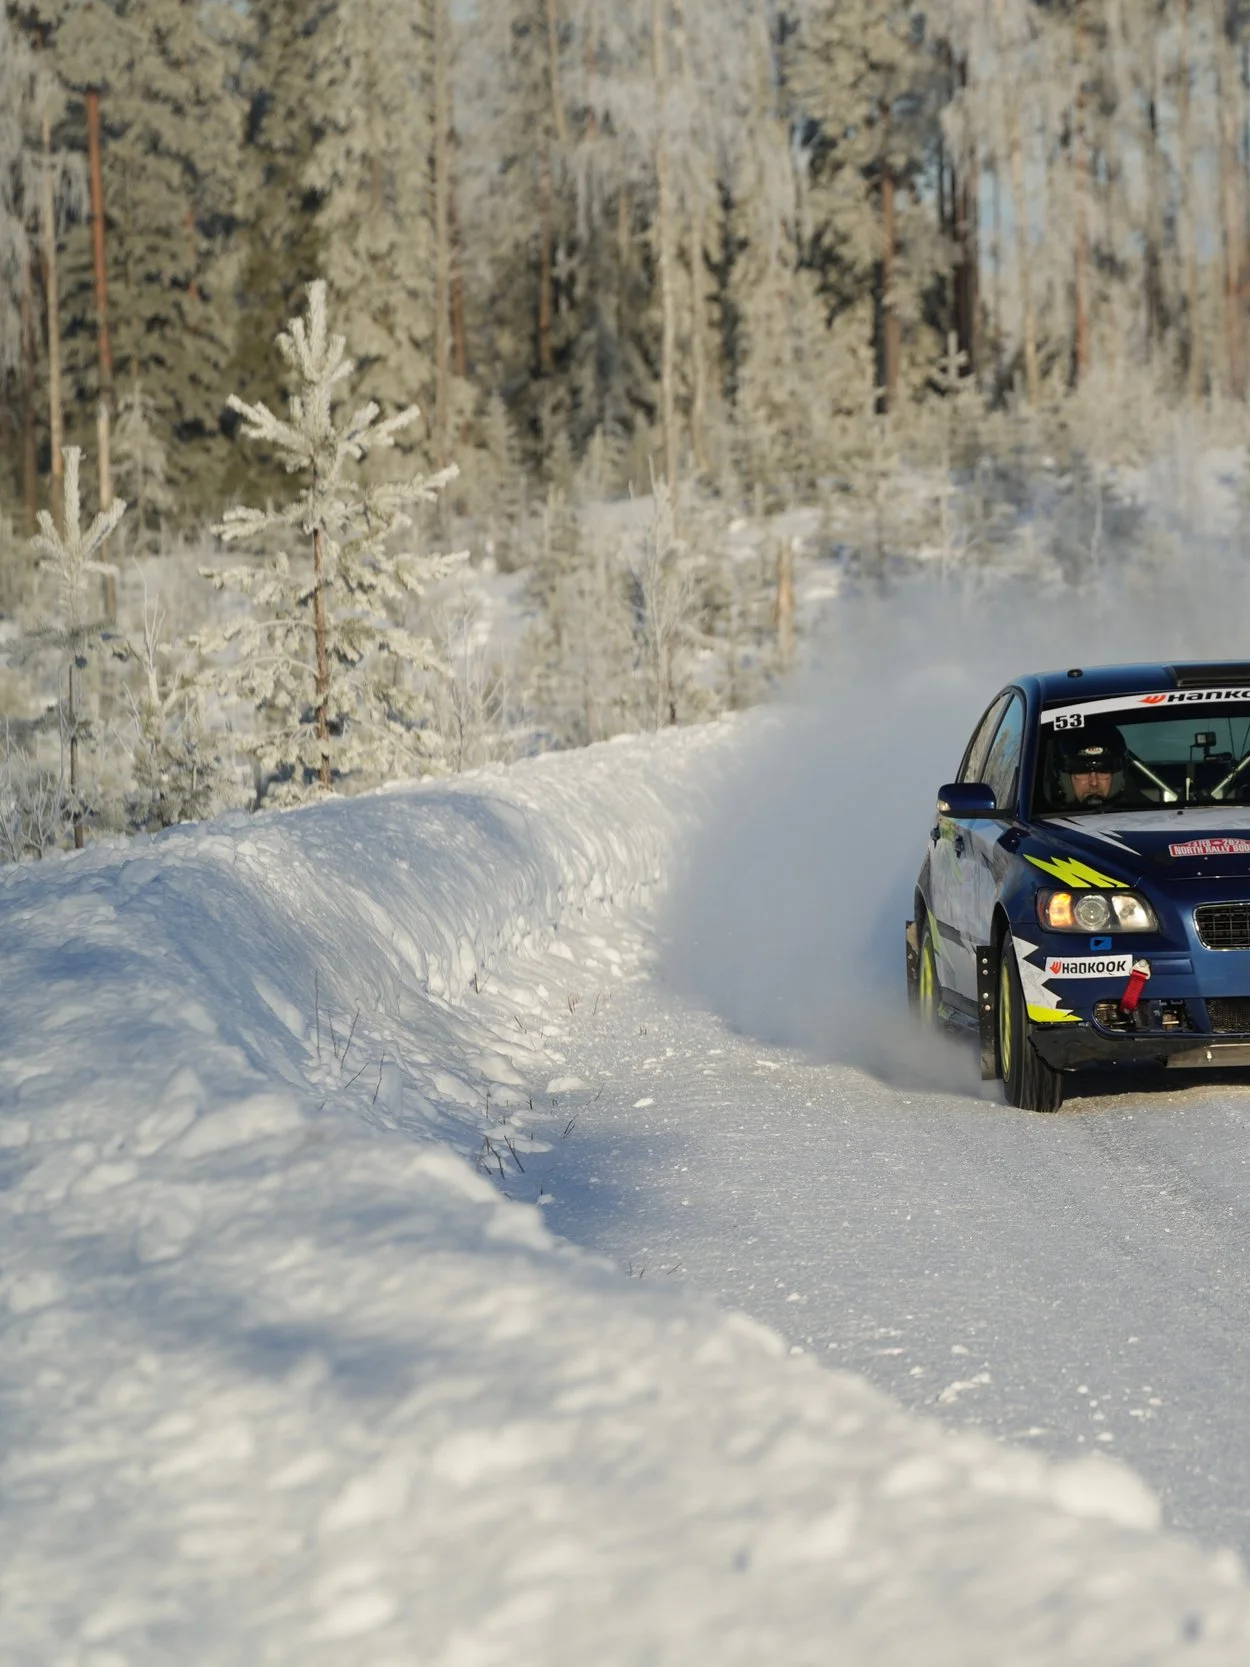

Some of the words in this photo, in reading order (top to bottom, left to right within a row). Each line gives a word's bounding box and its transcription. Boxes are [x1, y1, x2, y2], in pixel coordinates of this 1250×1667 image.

[1055, 714, 1083, 729] 53
[1174, 845, 1203, 855] NORTH
[1205, 844, 1230, 853] RALLY
